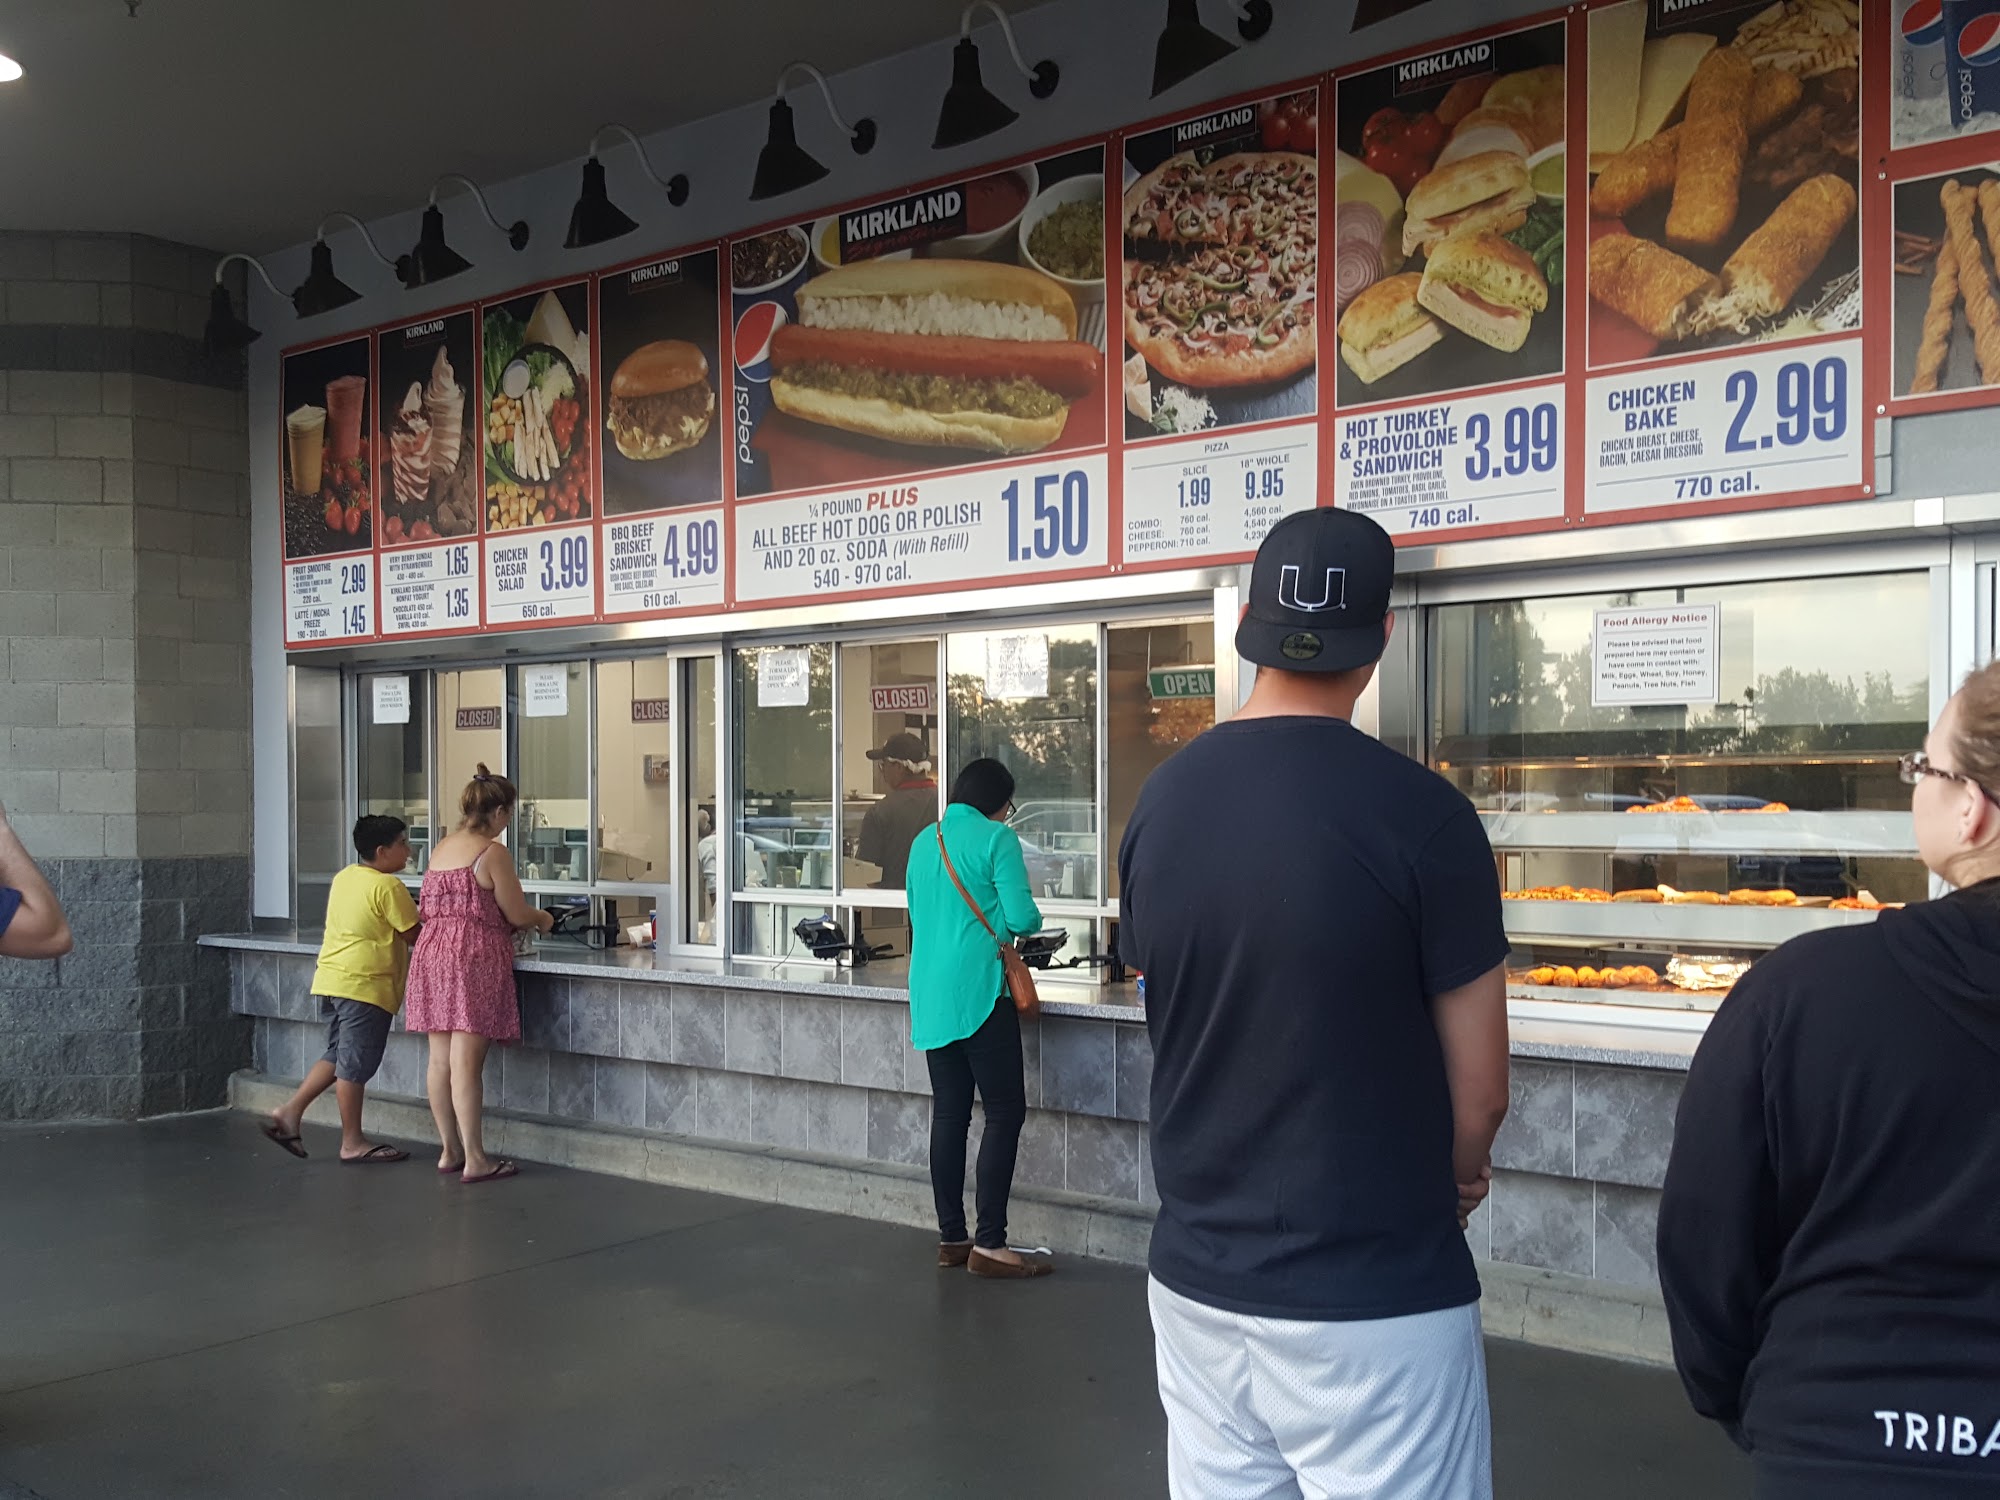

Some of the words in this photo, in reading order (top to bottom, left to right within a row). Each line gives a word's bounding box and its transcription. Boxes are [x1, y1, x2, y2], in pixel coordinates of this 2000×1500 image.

[1399, 44, 1490, 82] KIRKLAND
[1177, 108, 1253, 142] KIRKLAND
[846, 191, 961, 243] KIRKLAND
[631, 260, 679, 283] KIRKLAND
[406, 320, 444, 339] KIRKLAND
[1608, 380, 1695, 412] CHICKEN
[1724, 357, 1847, 454] 2.99
[734, 385, 754, 465] pepsi
[1346, 419, 1378, 440] HOT
[1384, 406, 1451, 432] TURKEY
[1625, 406, 1677, 432] BAKE
[1205, 442, 1229, 454] PIZZA
[1340, 442, 1351, 460] &
[1358, 426, 1457, 458] PROVOLONE
[1465, 403, 1557, 481] 3.99
[1601, 436, 1634, 454] CHICKEN
[1636, 433, 1667, 449] BREAST,
[1670, 428, 1702, 445] CHEESE,
[1183, 465, 1208, 477] SLICE
[1241, 458, 1254, 469] 18"
[1256, 453, 1290, 466] WHOLE
[1353, 448, 1442, 478] SANDWICH
[1600, 452, 1628, 468] BACON,
[1631, 448, 1660, 464] CAESAR
[1664, 443, 1703, 460] DRESSING
[1177, 476, 1211, 509] 1.99
[1245, 467, 1284, 500] 9.95
[1349, 491, 1358, 500] RED
[1360, 488, 1380, 499] ONIONS,
[1382, 485, 1410, 497] TOMATOES,
[1411, 482, 1426, 492] BASIL
[1428, 480, 1446, 490] GARLIC
[1351, 480, 1364, 490] OVEN
[1365, 477, 1390, 488] BROWNED
[1391, 475, 1411, 484] TURKEY,
[1413, 470, 1444, 482] PROVOLONE,
[1675, 475, 1713, 499] 770
[1720, 471, 1760, 495] cal.
[822, 498, 862, 517] POUND
[867, 486, 919, 511] PLUS
[1347, 500, 1379, 512] MAYONNAISE
[1380, 498, 1388, 507] ON
[1394, 494, 1417, 505] TOASTED
[1418, 492, 1434, 503] TORTA
[1436, 490, 1448, 500] ROLL
[753, 529, 777, 549] ALL
[782, 523, 817, 545] BEEF
[823, 518, 853, 541] HOT
[859, 514, 890, 536] DOG
[896, 511, 917, 532] OR
[924, 501, 981, 528] POLISH
[1001, 470, 1088, 562] 1.50
[1128, 519, 1162, 530] COMBO:
[1180, 515, 1194, 524] 760
[1196, 513, 1210, 523] cal.
[1244, 506, 1266, 518] 4,560
[1269, 505, 1284, 514] cal.
[1409, 508, 1440, 529] 740
[1446, 504, 1479, 525] cal.
[611, 525, 629, 541] BBQ
[632, 522, 654, 538] BEEF
[1128, 529, 1164, 542] CHEESE:
[1180, 526, 1194, 536] 760
[1196, 524, 1211, 534] cal.
[1244, 518, 1267, 529] 4,540
[1128, 539, 1178, 553] PEPPERONI:
[1180, 538, 1194, 548] 710
[1196, 536, 1211, 546] cal.
[1244, 530, 1266, 541] 4,230
[389, 556, 400, 564] VERY
[401, 554, 415, 562] BERRY
[416, 552, 432, 561] SUNDAE
[493, 547, 528, 564] CHICKEN
[614, 538, 652, 556] BRISKET
[663, 519, 718, 578] 4.99
[764, 551, 792, 571] AND
[798, 548, 815, 566] 20
[821, 549, 840, 564] oz.
[846, 539, 888, 562] SODA
[893, 540, 926, 561] (With
[930, 532, 969, 553] Refill)
[293, 566, 306, 575] FRUIT
[307, 562, 331, 574] SMOOTHIE
[446, 546, 468, 576] 1.65
[495, 562, 527, 578] CAESAR
[540, 535, 588, 591] 3.99
[610, 553, 657, 572] SANDWICH
[341, 563, 366, 594] 2.99
[498, 577, 524, 592] SALAD
[814, 569, 839, 588] 540
[855, 564, 881, 584] 970
[886, 560, 911, 581] cal.
[312, 594, 322, 603] cal.
[390, 585, 411, 595] KIRKLAND
[412, 583, 435, 593] SIGNATURE
[413, 592, 429, 601] YOGURT
[644, 593, 660, 608] 610
[663, 591, 681, 605] cal.
[1279, 565, 1346, 612] U
[294, 608, 309, 619] LATTÉ
[313, 608, 330, 618] MOCHA
[446, 587, 469, 618] 1.35
[522, 604, 538, 618] 650
[540, 603, 556, 616] cal.
[303, 619, 321, 628] FREEZE
[342, 604, 366, 635] 1.45
[1603, 618, 1628, 627] Food
[1632, 616, 1668, 626] Allergy
[1672, 614, 1708, 623] Notice
[319, 628, 328, 637] cal.
[1608, 640, 1630, 648] Please
[1604, 651, 1634, 660] prepared
[1653, 650, 1668, 658] may
[1655, 659, 1681, 667] contact
[1163, 672, 1211, 694] OPEN
[1640, 670, 1664, 678] Wheat,
[1683, 669, 1708, 677] Honey,
[1644, 681, 1659, 689] Tree
[874, 688, 927, 709] CLOSED
[458, 710, 493, 726] CLOSED
